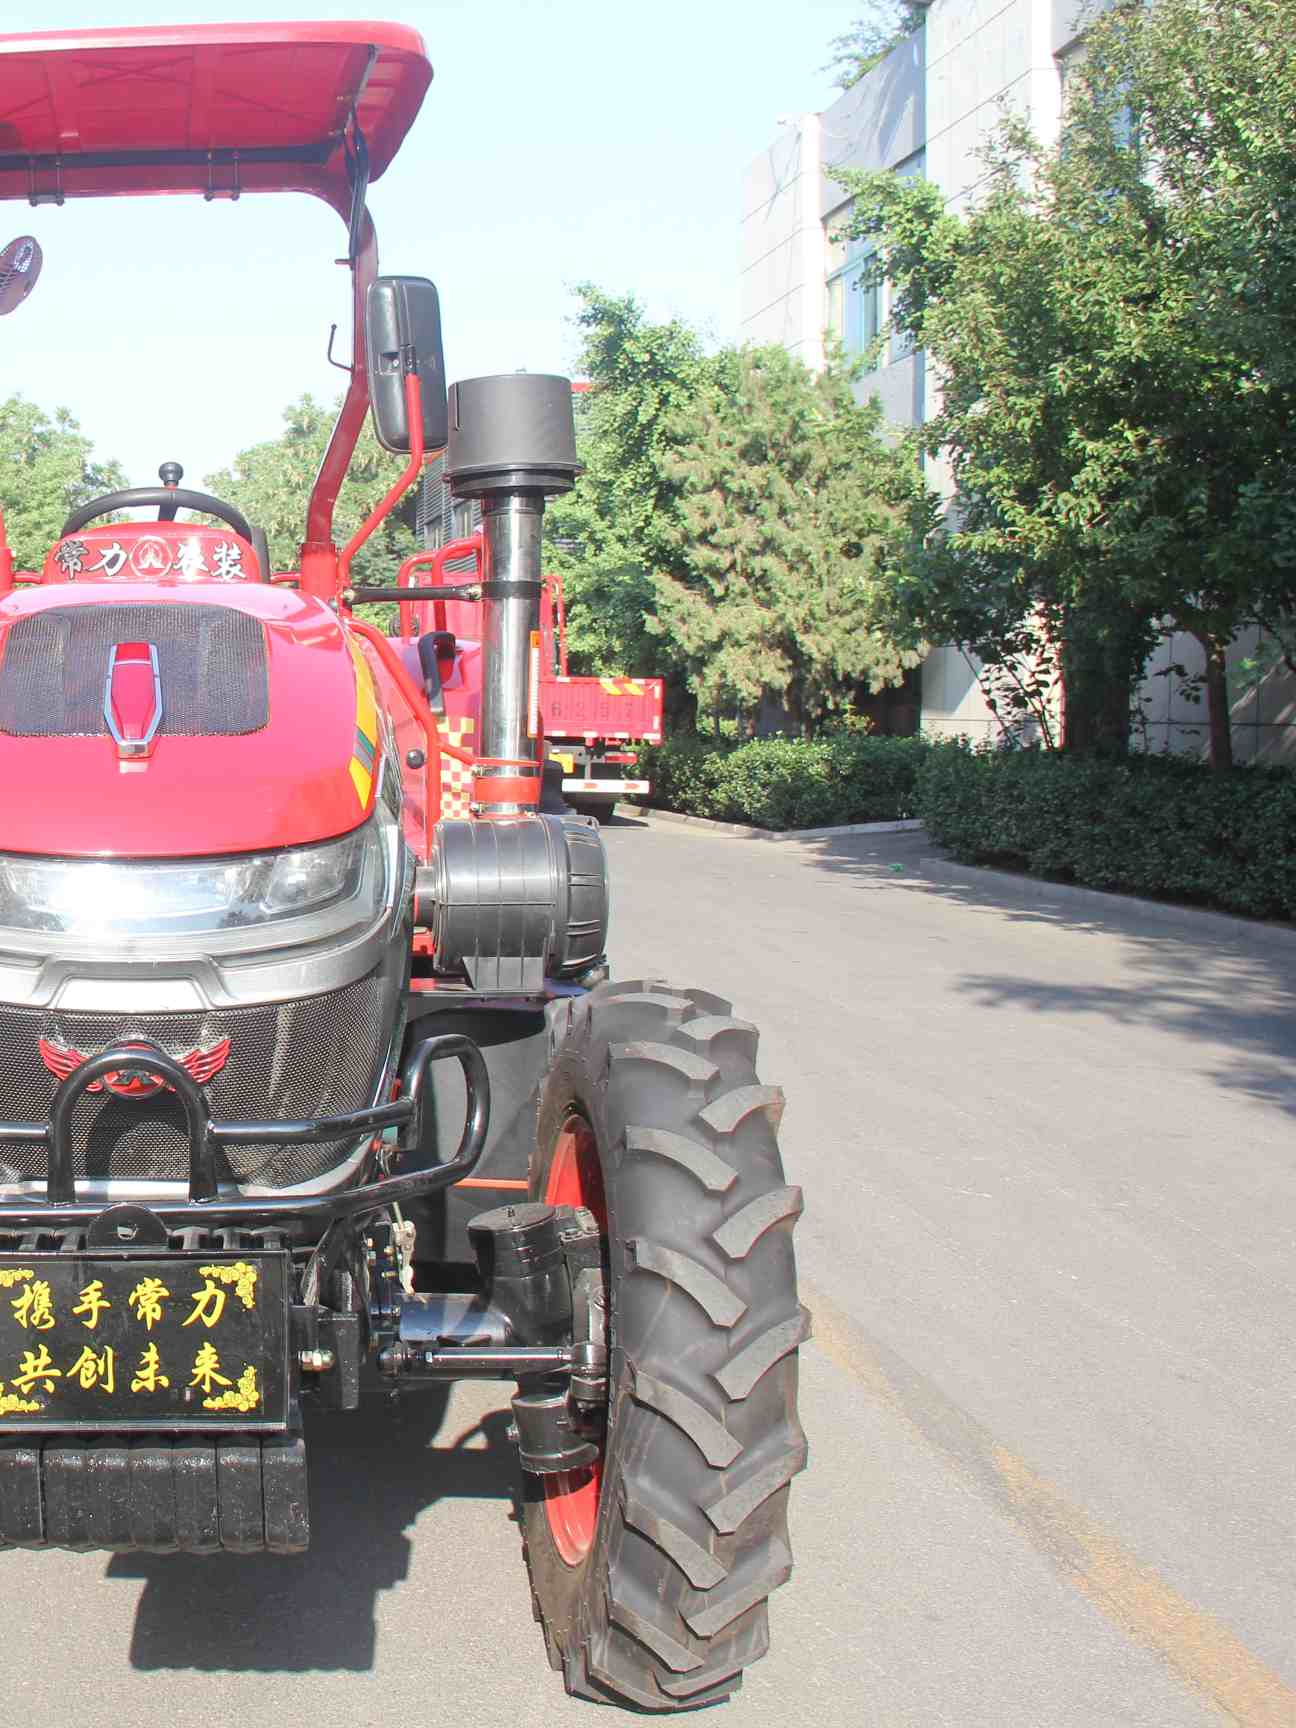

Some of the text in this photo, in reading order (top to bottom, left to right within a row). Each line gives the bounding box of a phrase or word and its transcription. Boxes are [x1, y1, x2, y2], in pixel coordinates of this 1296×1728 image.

[55, 539, 129, 579] 常力
[10, 1277, 226, 1331] 携手常力
[10, 1342, 233, 1394] 共创未来
